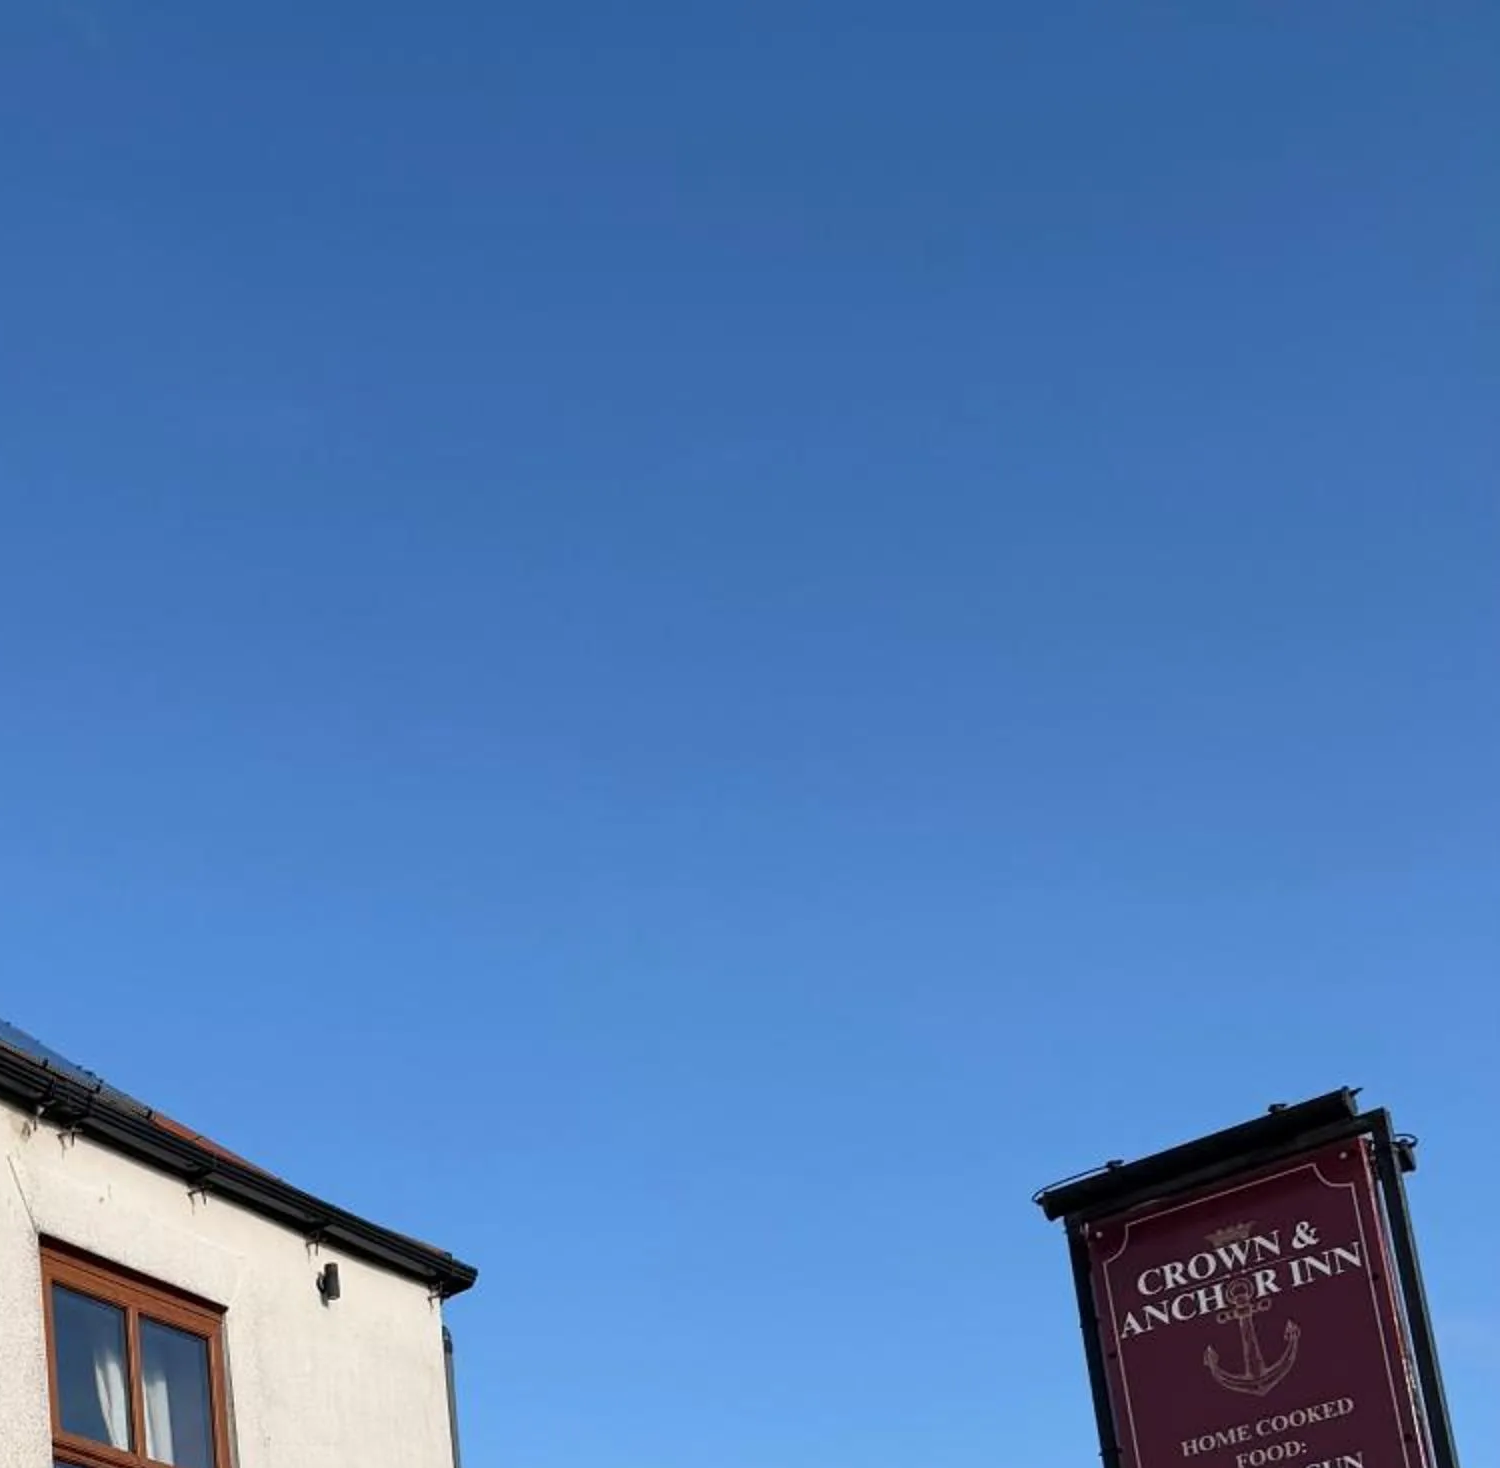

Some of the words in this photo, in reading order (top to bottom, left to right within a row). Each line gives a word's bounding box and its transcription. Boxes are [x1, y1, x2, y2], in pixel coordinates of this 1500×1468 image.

[1137, 1229, 1282, 1296] CROWN
[1291, 1220, 1321, 1249] &
[1288, 1241, 1363, 1288] INN
[1181, 1424, 1252, 1457] HOME
[1256, 1396, 1355, 1437] COOKED
